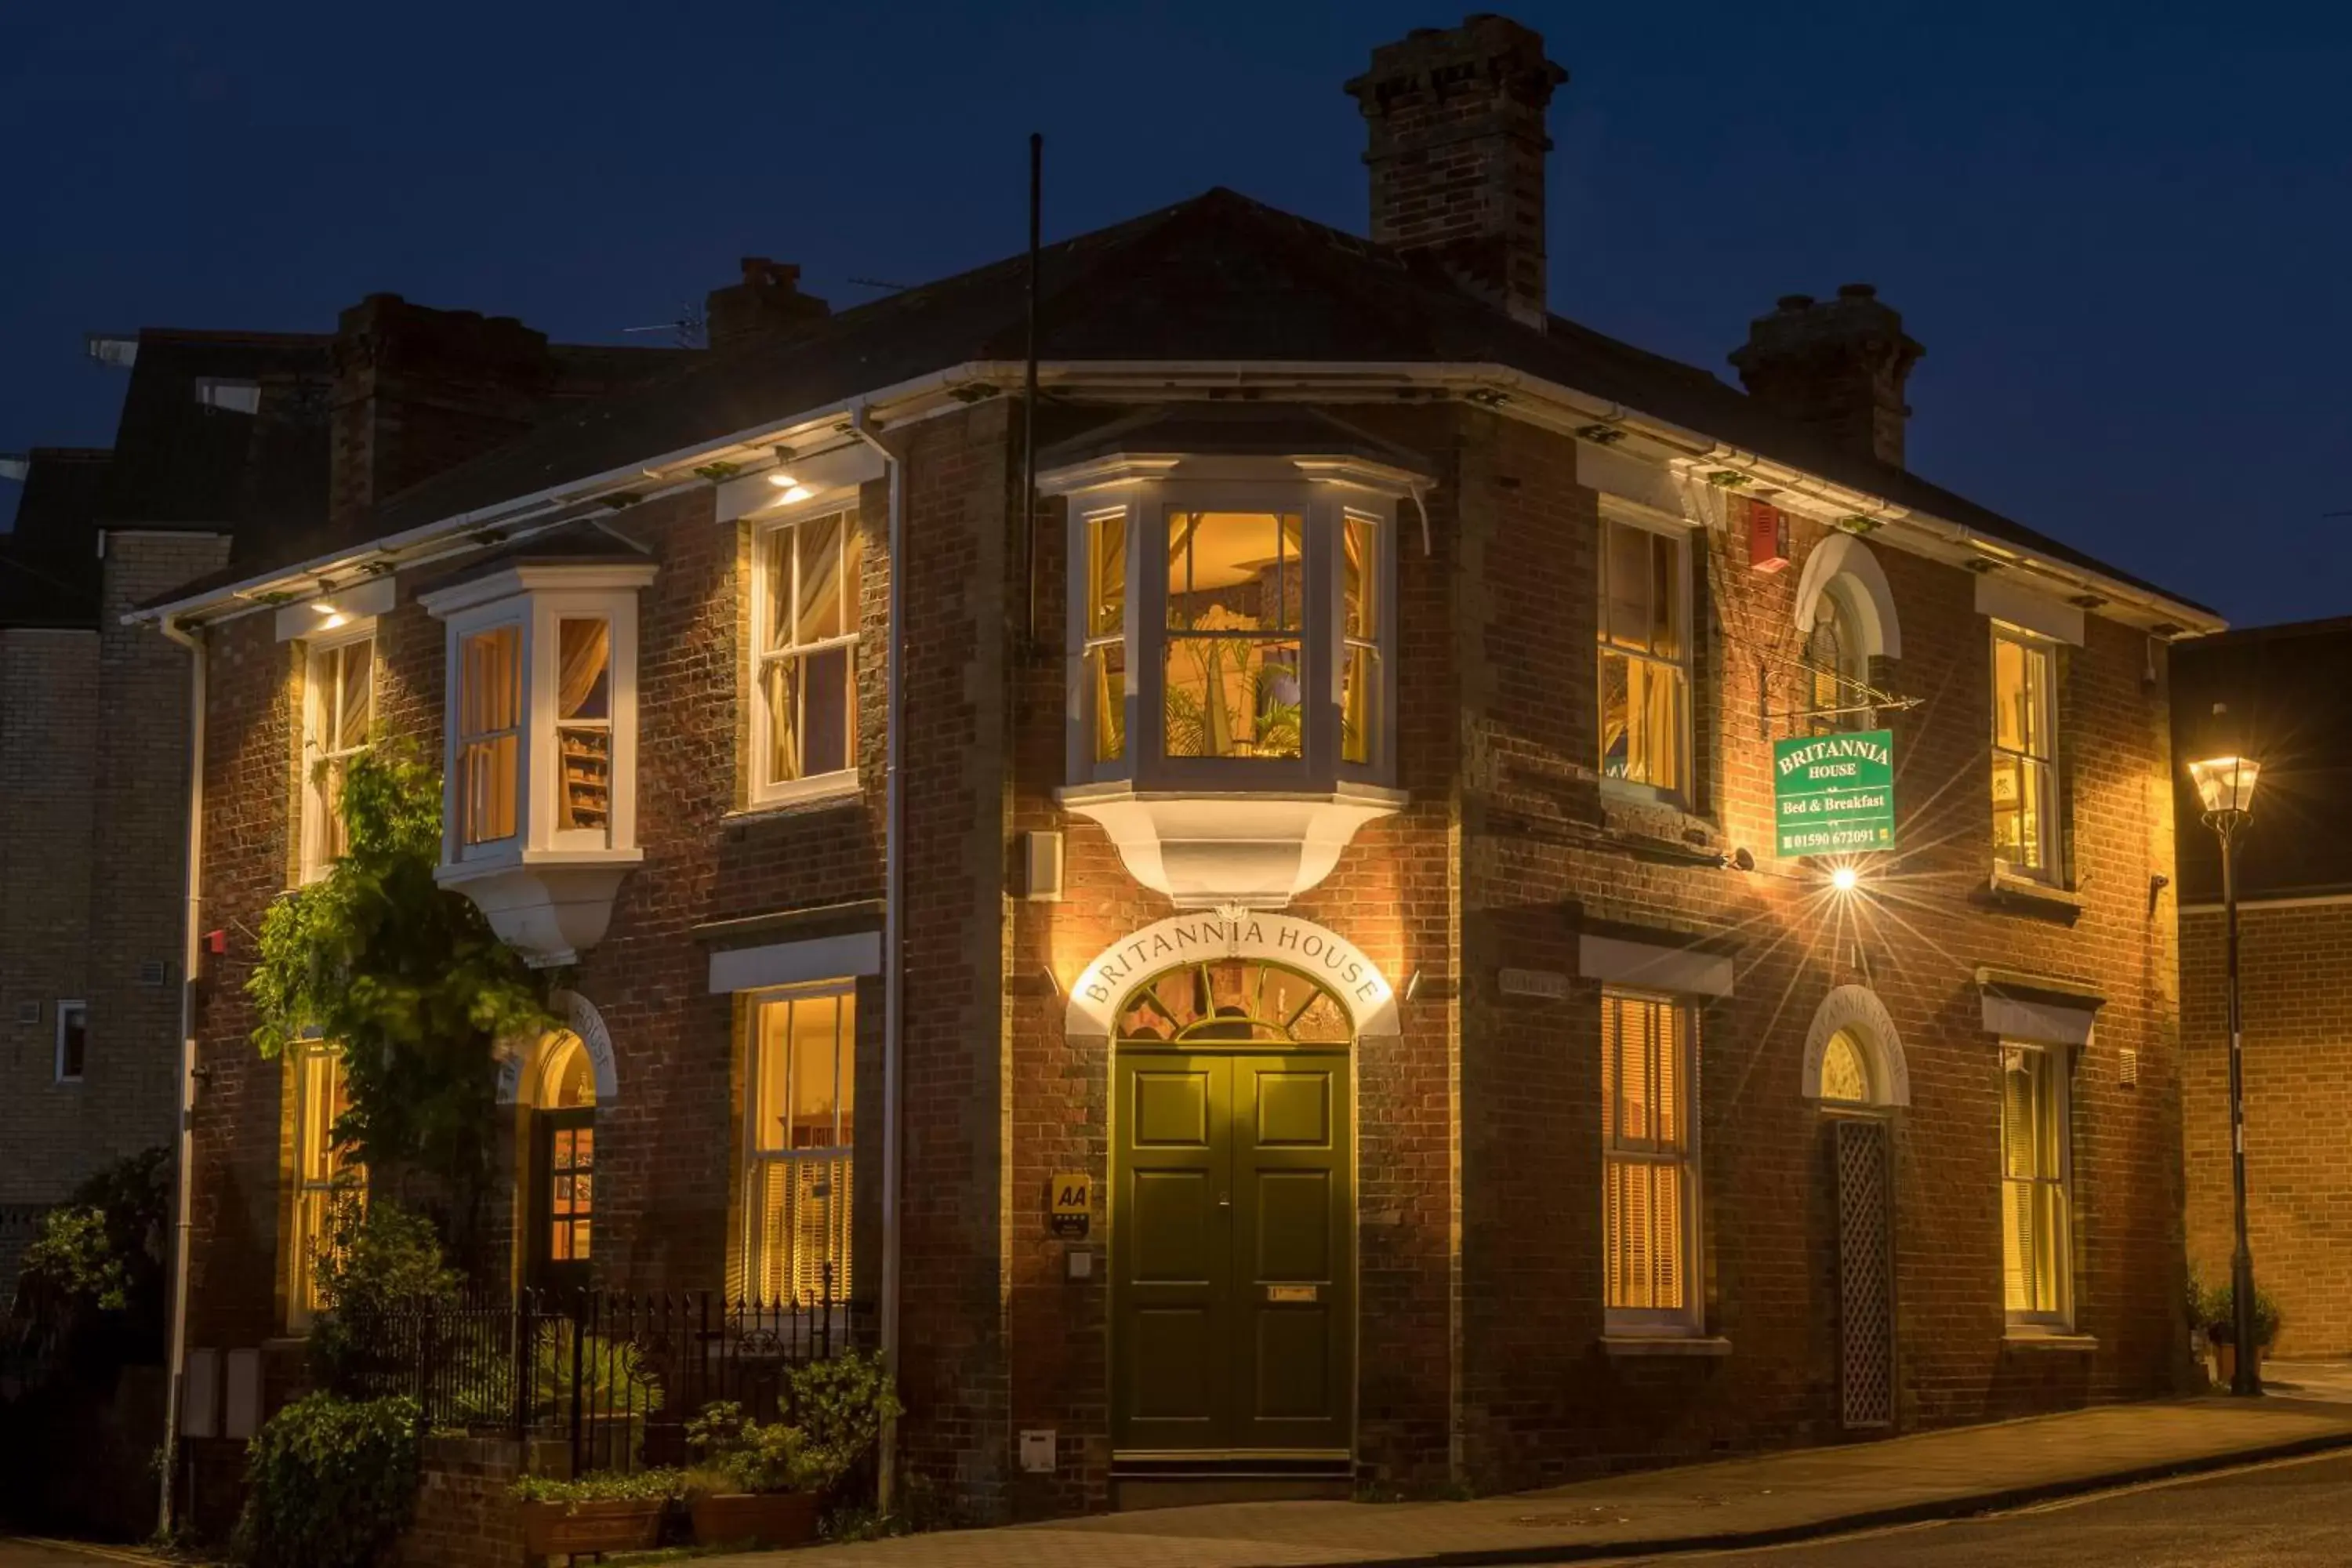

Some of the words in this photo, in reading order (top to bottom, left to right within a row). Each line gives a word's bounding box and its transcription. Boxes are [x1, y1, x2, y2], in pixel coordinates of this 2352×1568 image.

[1777, 739, 1889, 775] BRITANNIA
[1808, 763, 1857, 779] HOUSE
[1782, 799, 1806, 815] Bed
[1809, 798, 1822, 812] &
[1824, 794, 1885, 811] Breakfast
[1794, 833, 1830, 848] 01590
[1832, 829, 1875, 845] 672091
[1085, 920, 1264, 1004] BRITANNIA
[1278, 926, 1378, 1003] HOUSE
[1058, 1185, 1087, 1207] AA
